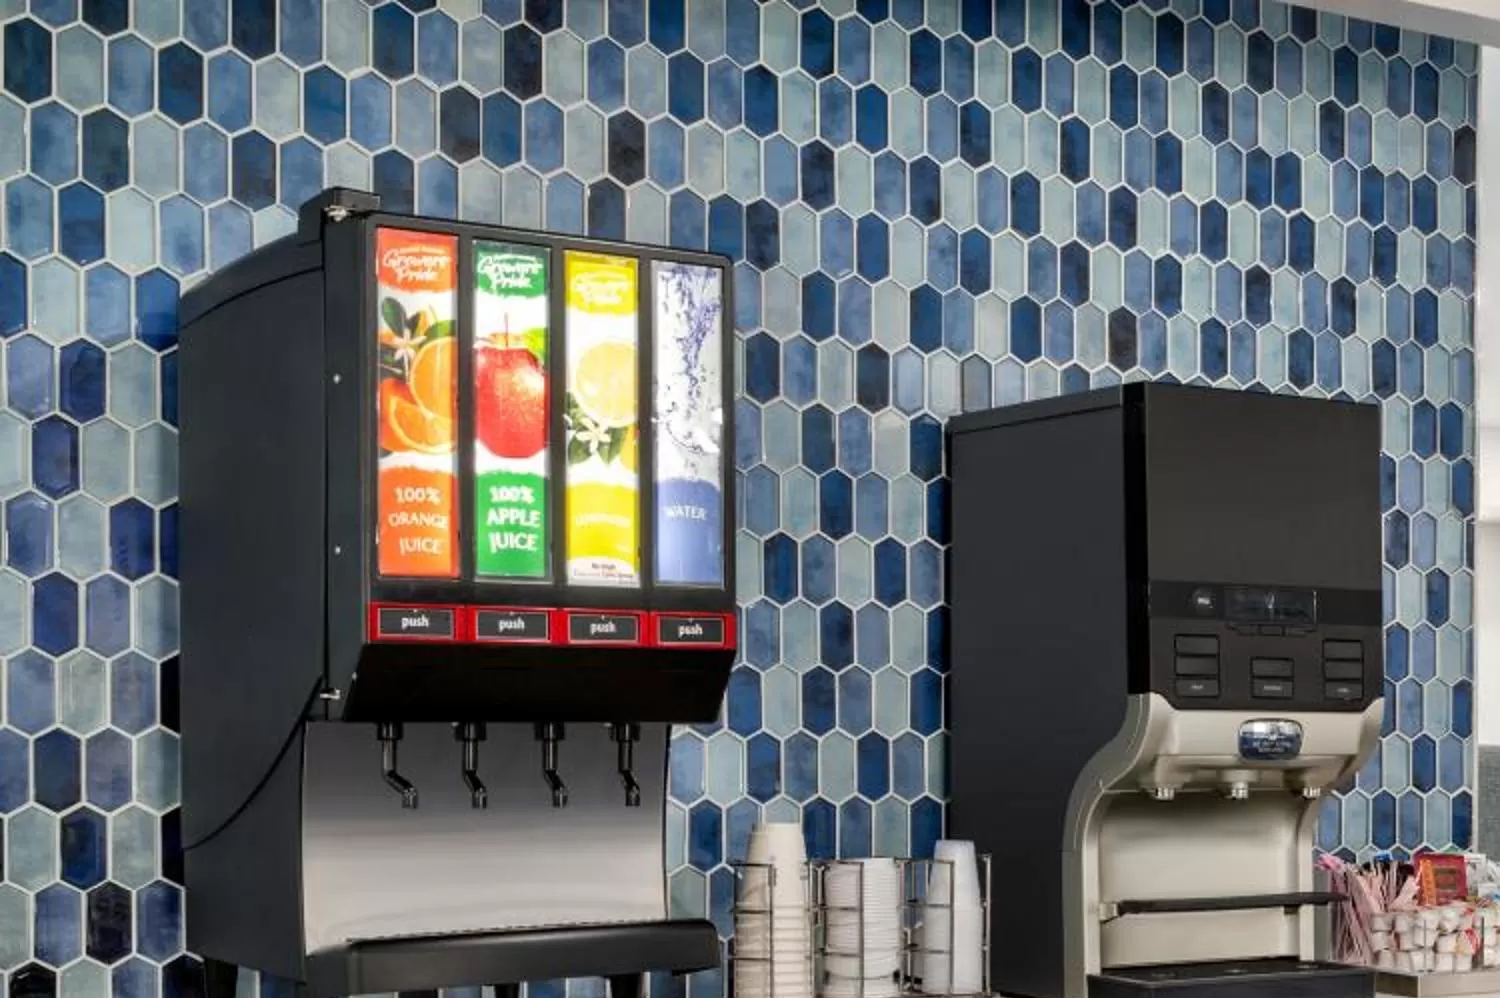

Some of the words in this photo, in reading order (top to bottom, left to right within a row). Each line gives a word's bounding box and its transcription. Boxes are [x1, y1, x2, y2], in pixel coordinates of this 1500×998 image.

[394, 485, 442, 505] 100%
[489, 484, 536, 504] 100%
[387, 511, 449, 529] ORANGE
[486, 507, 541, 528] APPLE
[664, 503, 707, 521] WATER
[399, 535, 442, 556] JUICE
[489, 531, 539, 554] JUICE
[401, 614, 430, 631] push
[498, 617, 526, 633] push
[590, 620, 617, 635] push
[678, 623, 704, 638] push
